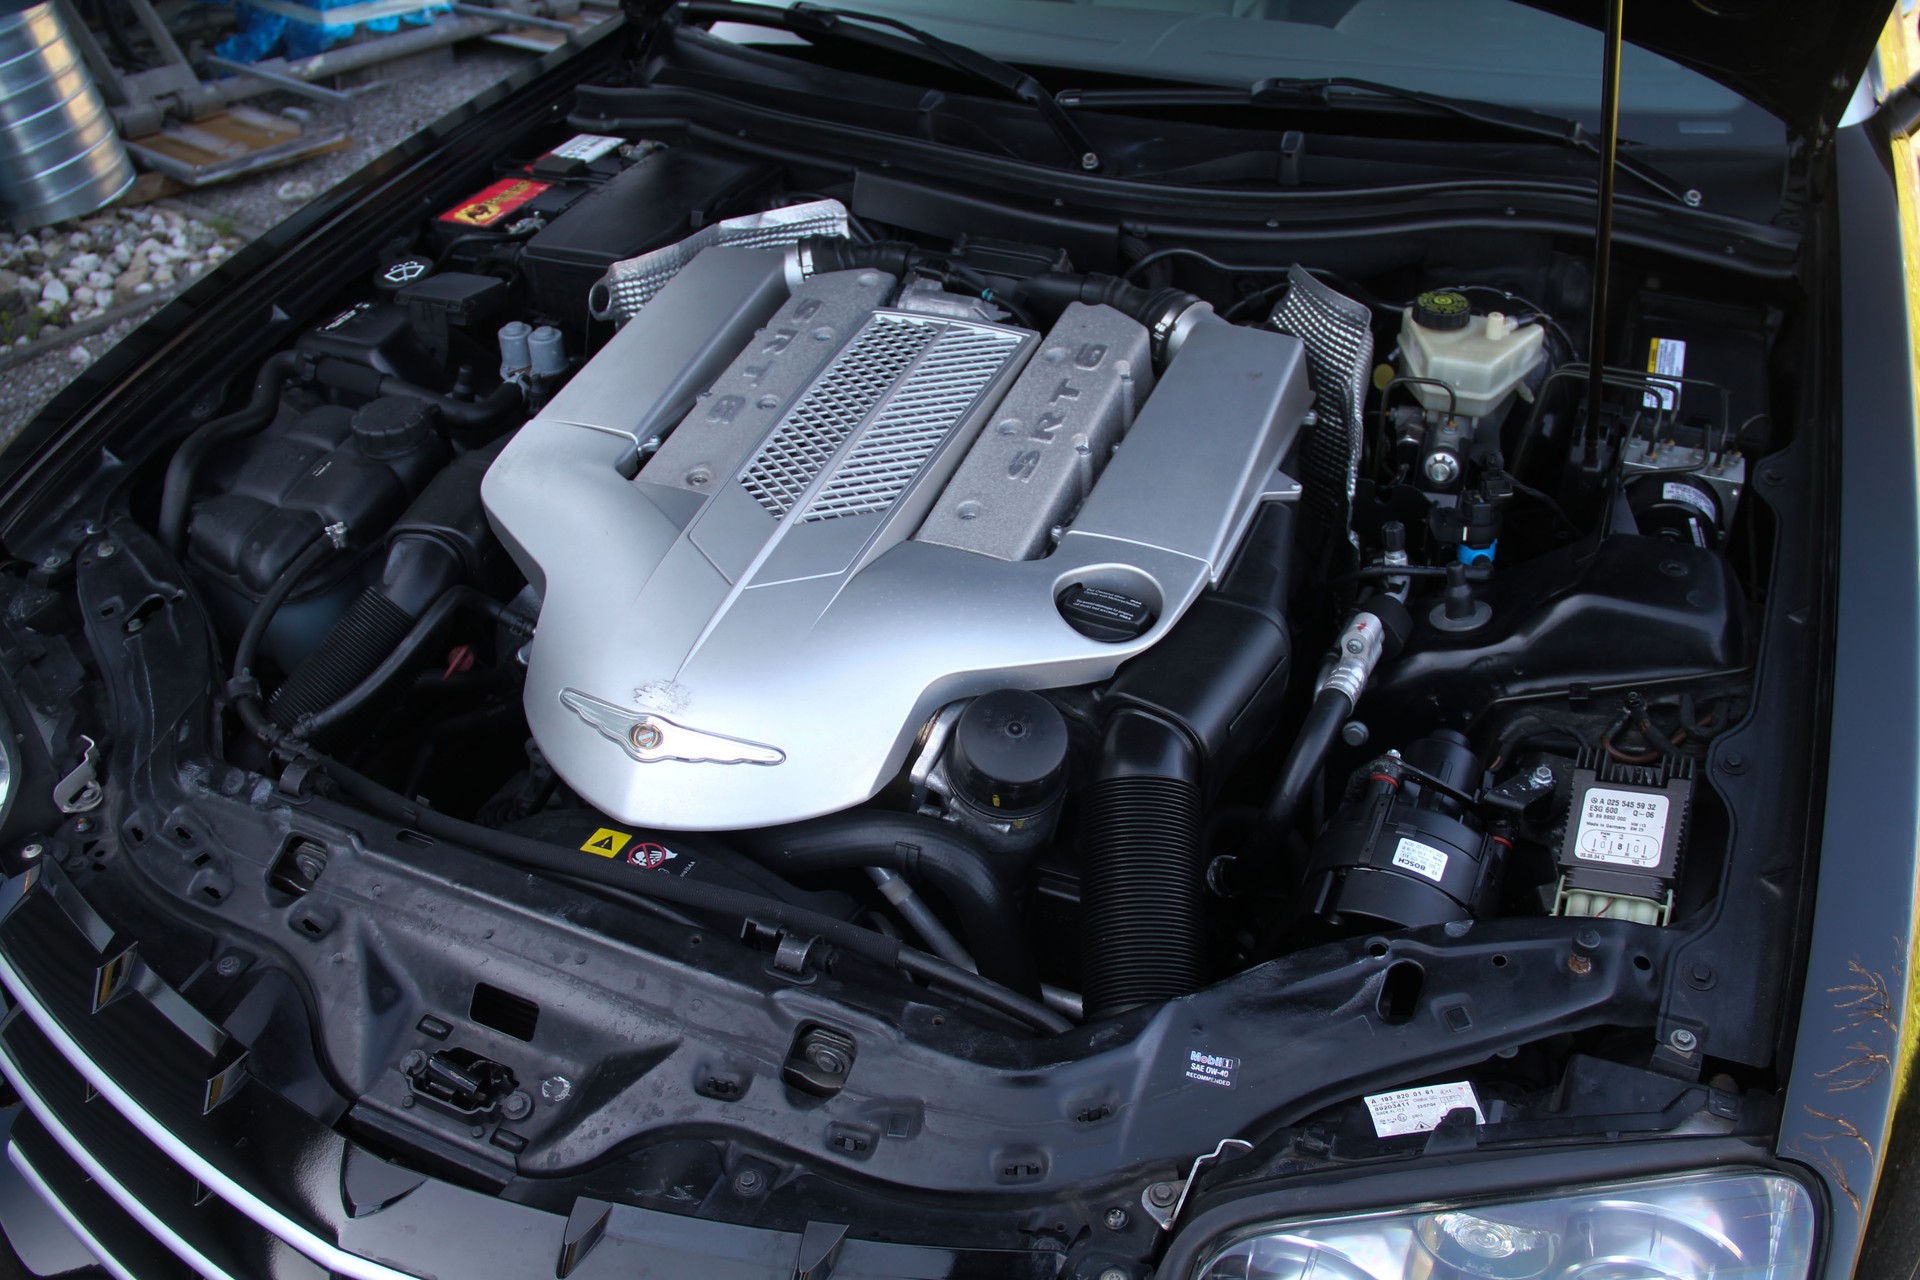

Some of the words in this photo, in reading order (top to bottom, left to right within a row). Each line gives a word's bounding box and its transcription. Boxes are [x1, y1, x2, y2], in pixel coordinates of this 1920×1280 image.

[1589, 804, 1603, 812] ESG
[1606, 798, 1619, 806] 025
[1621, 800, 1634, 808] 545
[1636, 801, 1646, 809] 59
[1647, 803, 1657, 811] 32
[1398, 857, 1426, 872] BOSCH
[1190, 1062, 1205, 1073] SAE
[1206, 1066, 1229, 1078] 0W-40
[1185, 1071, 1231, 1087] RECOMMENDED
